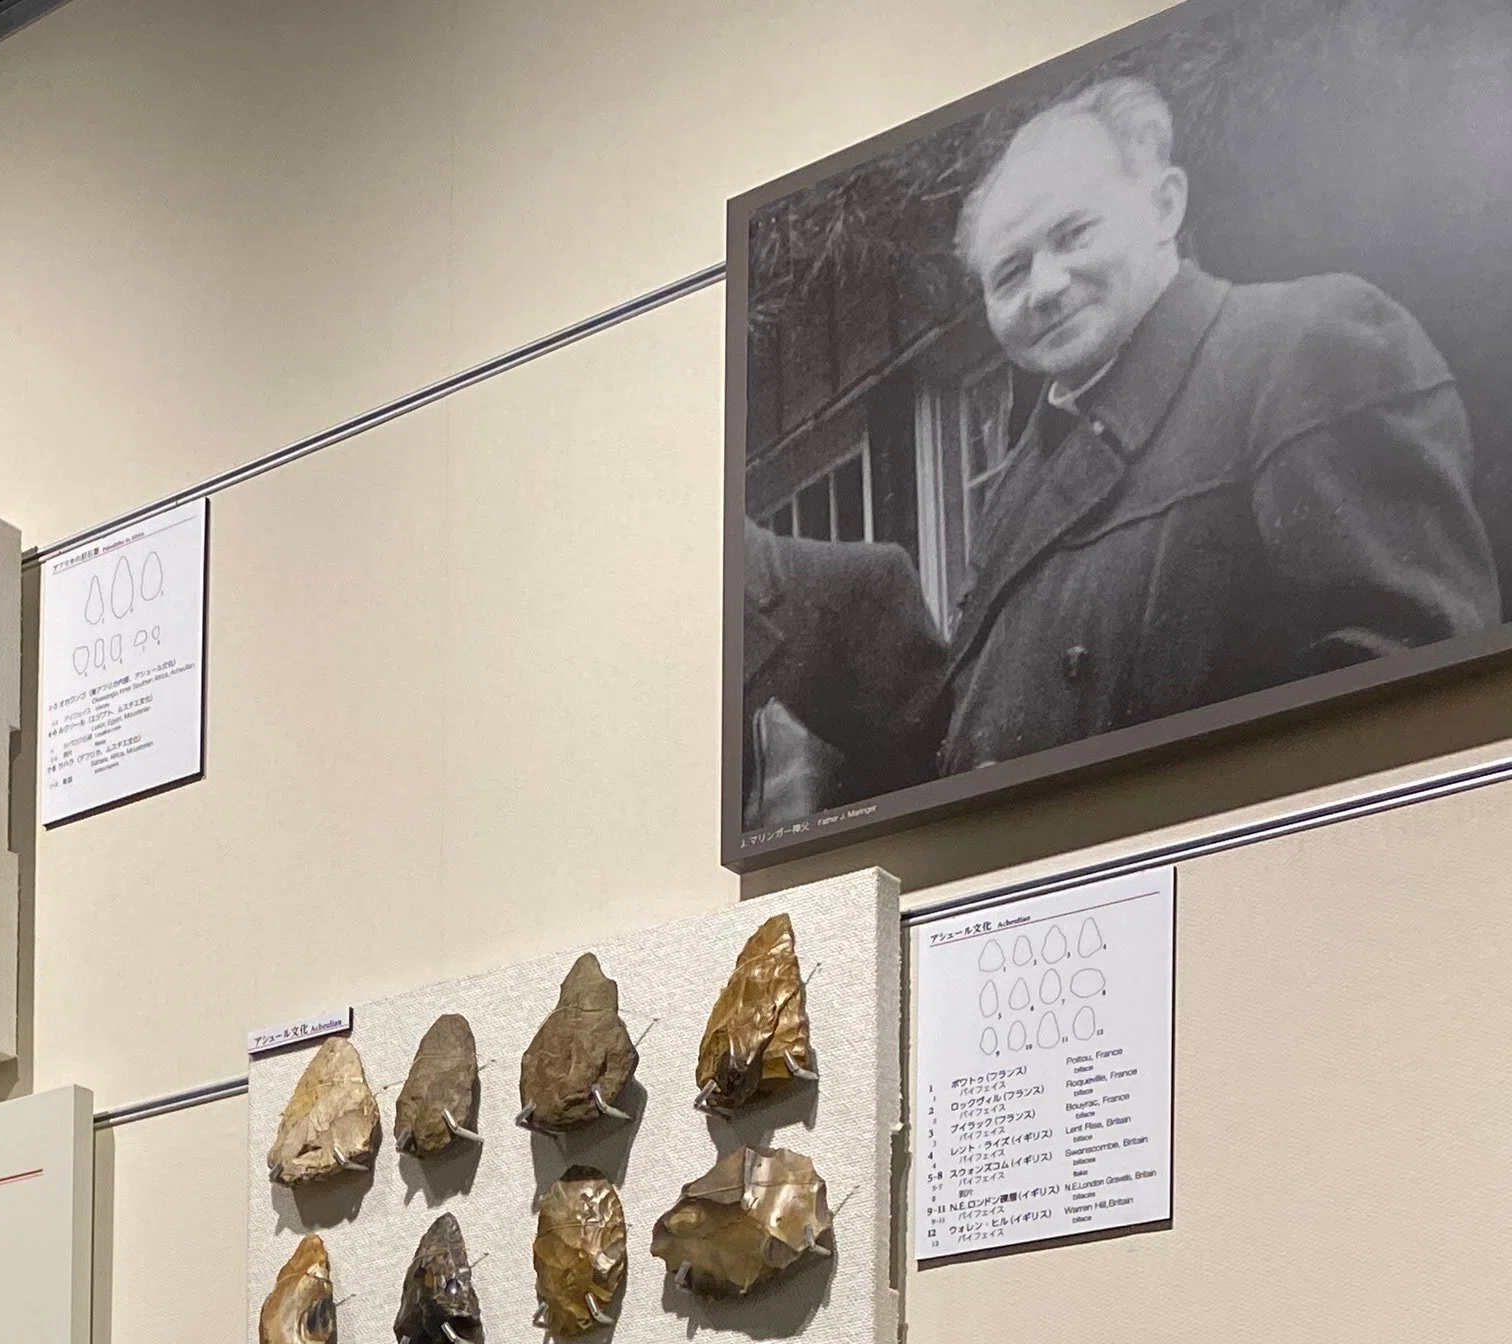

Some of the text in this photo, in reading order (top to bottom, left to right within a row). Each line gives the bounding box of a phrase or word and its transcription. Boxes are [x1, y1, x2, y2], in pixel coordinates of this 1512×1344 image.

[930, 921, 992, 943] アシュール文化
[254, 1024, 308, 1046] アシュール文化
[1096, 1049, 1123, 1059] France
[1110, 1069, 1137, 1079] France
[1102, 1093, 1130, 1104] France
[1123, 1136, 1148, 1147] Britain
[1135, 1170, 1157, 1180] Britain
[928, 1229, 936, 1237] 12
